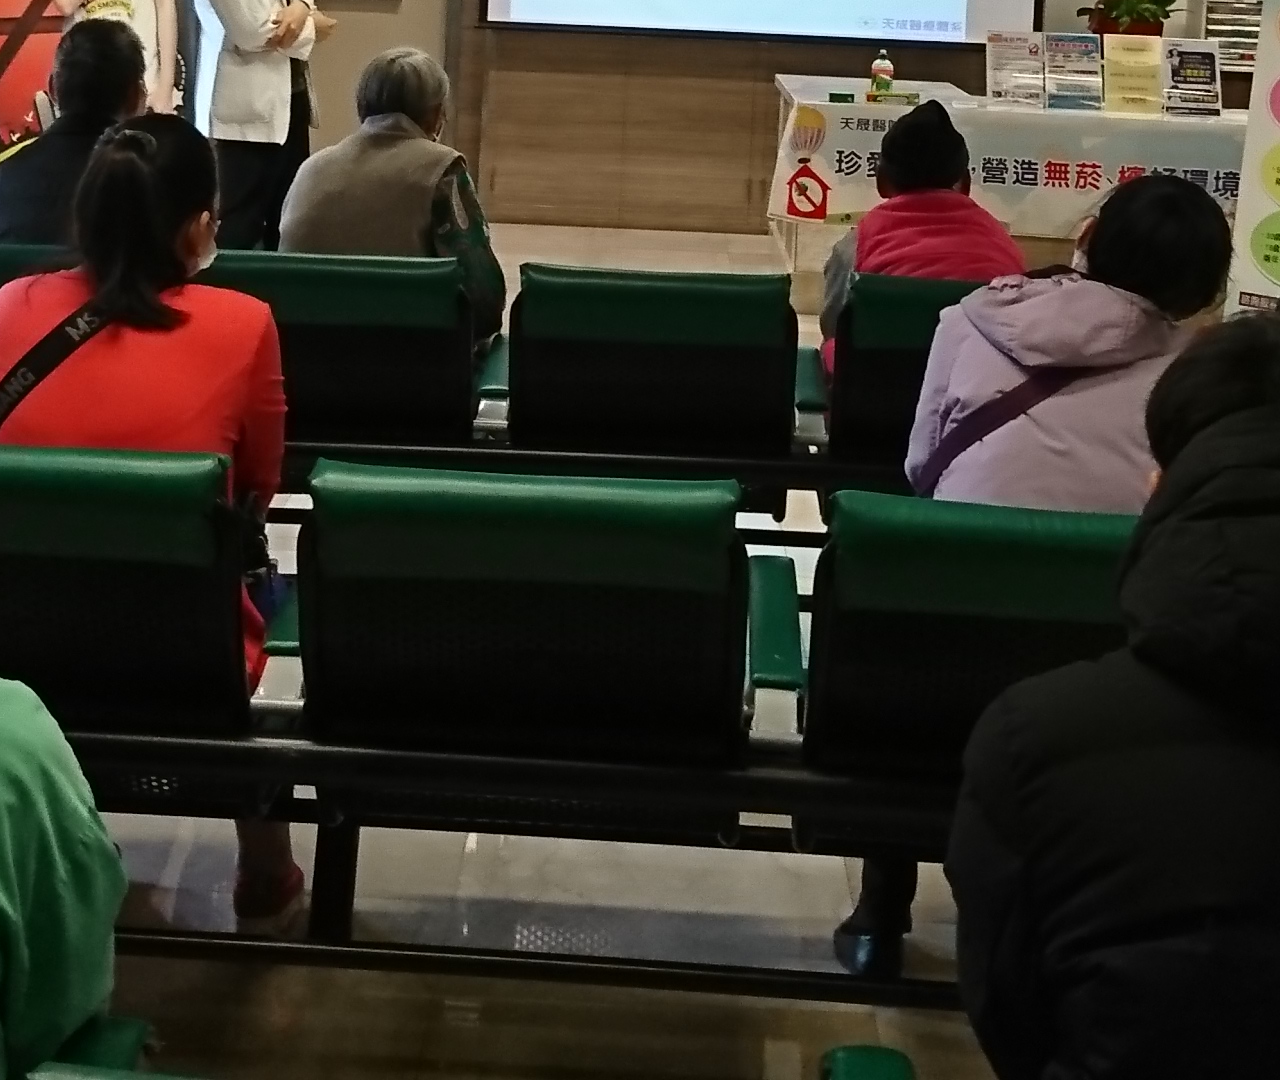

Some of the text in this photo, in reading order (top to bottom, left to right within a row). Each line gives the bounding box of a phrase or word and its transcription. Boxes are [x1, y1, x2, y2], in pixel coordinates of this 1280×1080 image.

[882, 18, 963, 33] 天成醫療體系
